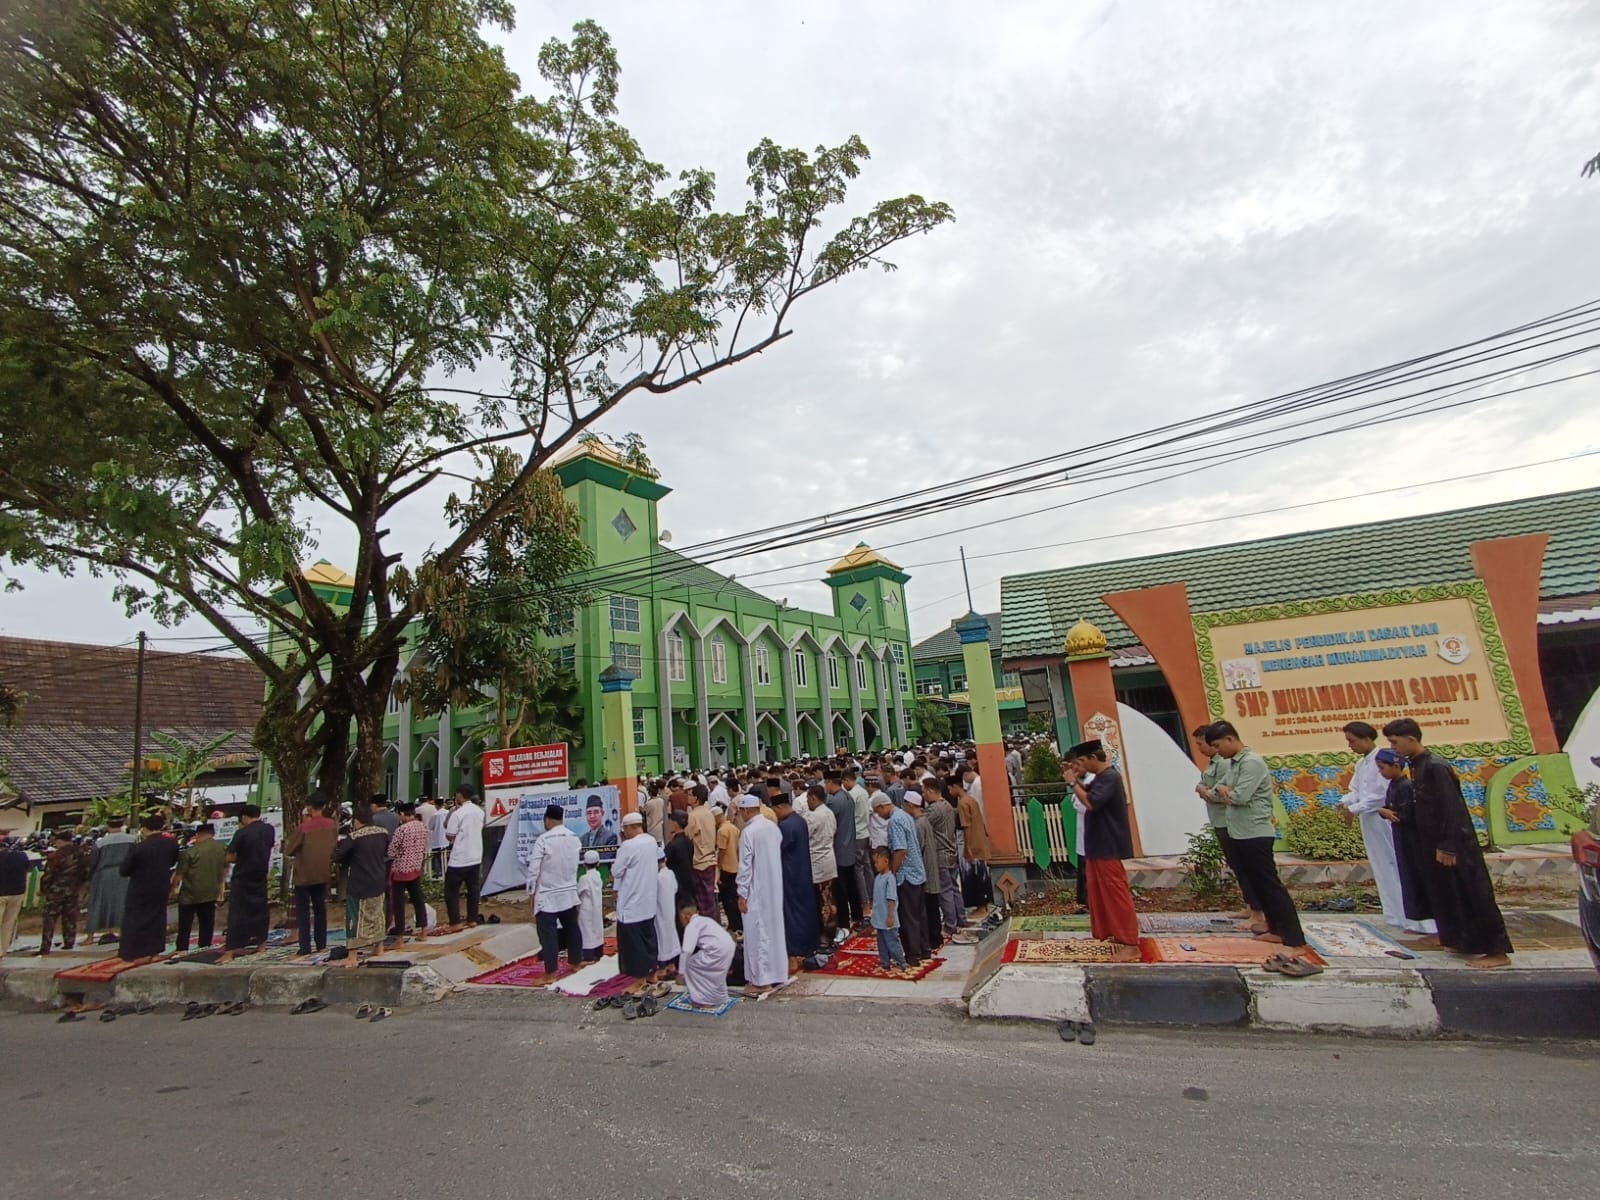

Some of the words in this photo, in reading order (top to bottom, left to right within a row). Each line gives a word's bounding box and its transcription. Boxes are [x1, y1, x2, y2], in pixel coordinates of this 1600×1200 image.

[1244, 638, 1292, 655] MAJELIS
[1295, 630, 1367, 649] PENDIDIKAN
[1368, 626, 1411, 642] DASAR
[1411, 623, 1440, 637] DAN
[1262, 655, 1325, 672] MENENGAH
[1327, 645, 1428, 665] MUHAMMADIYAH
[1235, 690, 1269, 717] SMP
[1272, 679, 1408, 715] MUHAMMADIYAH
[1409, 673, 1479, 704] SAMPIT
